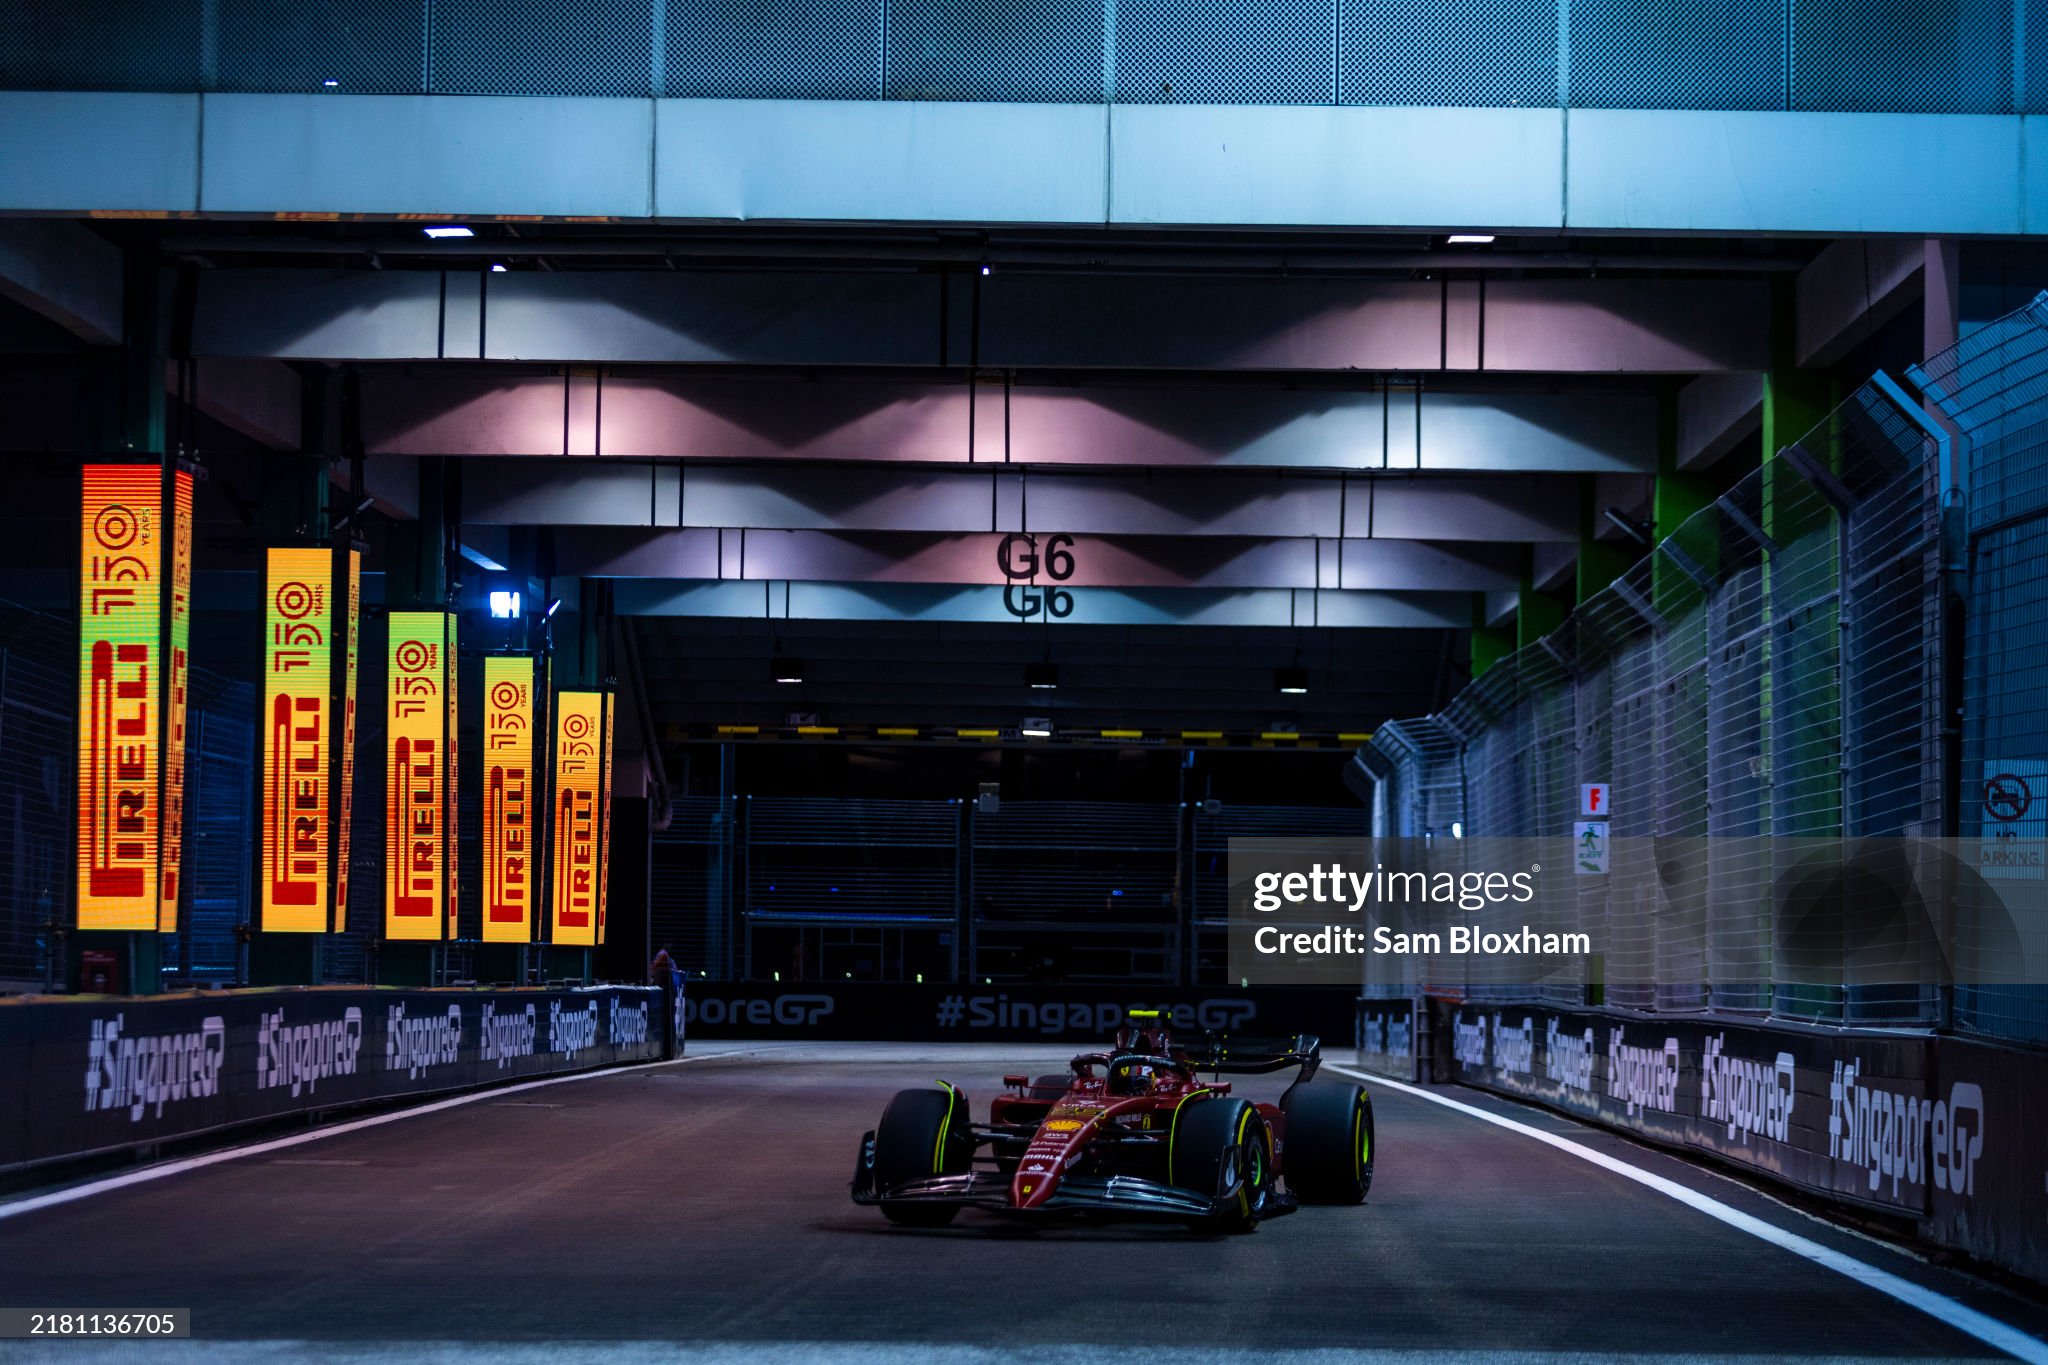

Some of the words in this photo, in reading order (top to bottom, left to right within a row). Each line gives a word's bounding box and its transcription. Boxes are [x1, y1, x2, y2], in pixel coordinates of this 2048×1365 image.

[140, 508, 151, 547] YEARS
[997, 534, 1075, 580] G6
[1003, 585, 1074, 618] G6
[90, 640, 148, 897] PIRELLI
[272, 693, 321, 906] PIRELLI
[1590, 788, 1601, 811] F
[394, 736, 436, 917] PIRELLI
[489, 765, 525, 923] PIRELLI
[559, 788, 593, 927] PIRELLI
[84, 1012, 225, 1122] #SingaporeGP
[257, 1006, 362, 1099] #SingaporeGP
[385, 1000, 461, 1081] #SingaporeGP
[1607, 1025, 1680, 1120] #SingaporeGP
[1701, 1031, 1796, 1145] #SingaporeGP
[1829, 1056, 1984, 1199] #SingaporeGP
